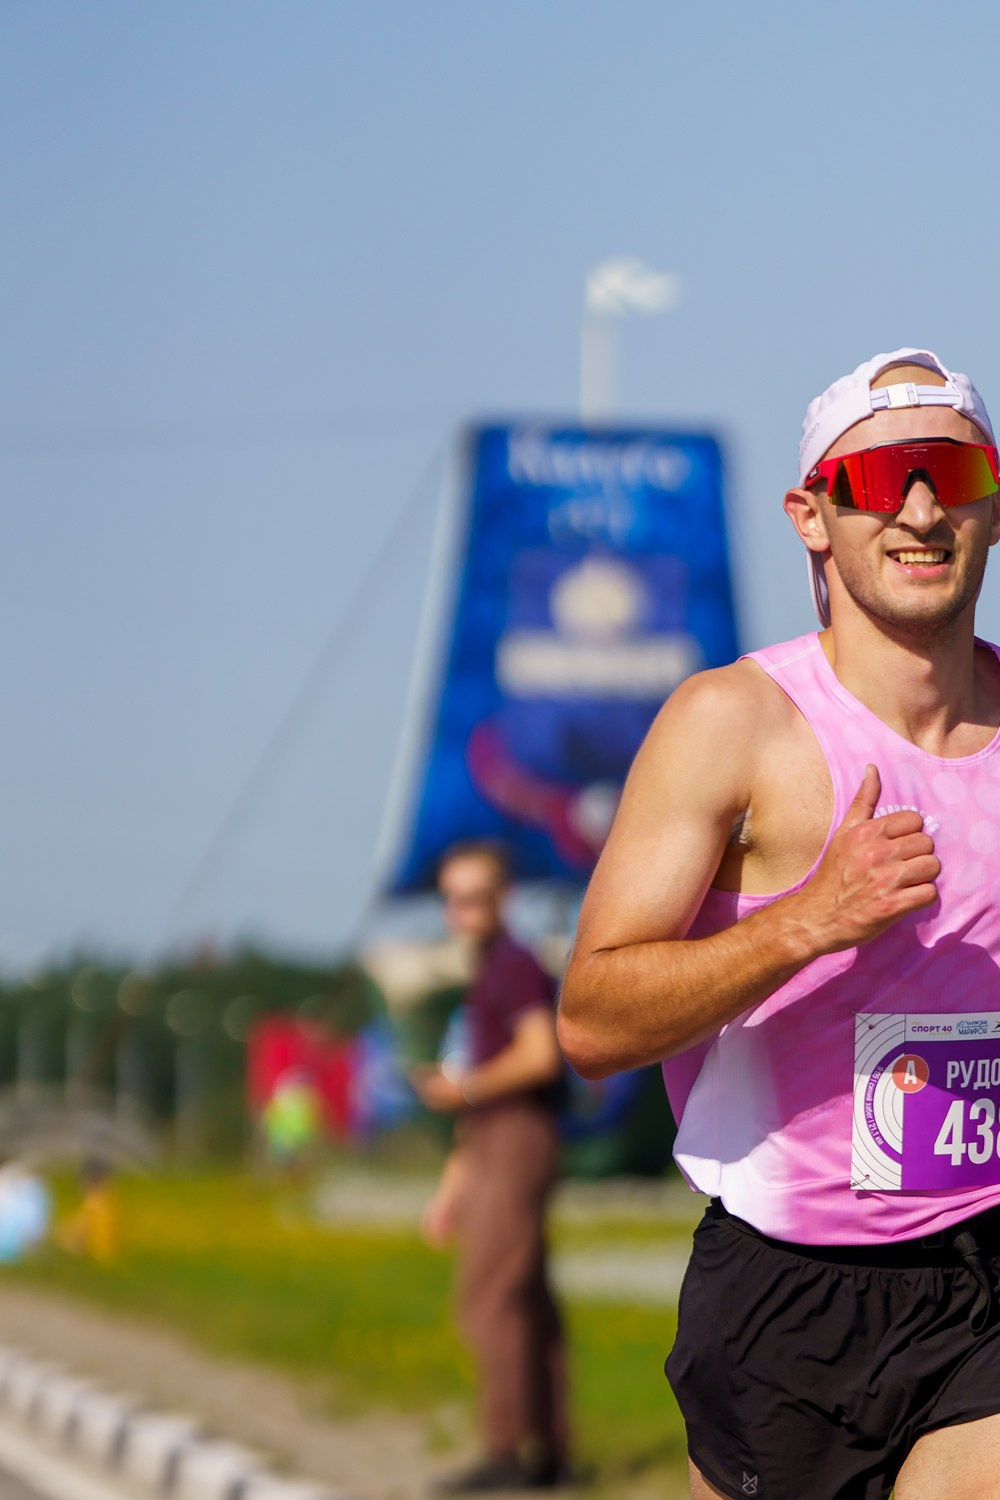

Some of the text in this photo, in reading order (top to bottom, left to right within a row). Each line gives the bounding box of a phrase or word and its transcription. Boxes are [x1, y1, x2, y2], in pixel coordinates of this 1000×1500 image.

[911, 1025, 953, 1033] СПОРТ 40
[903, 1060, 918, 1085] А
